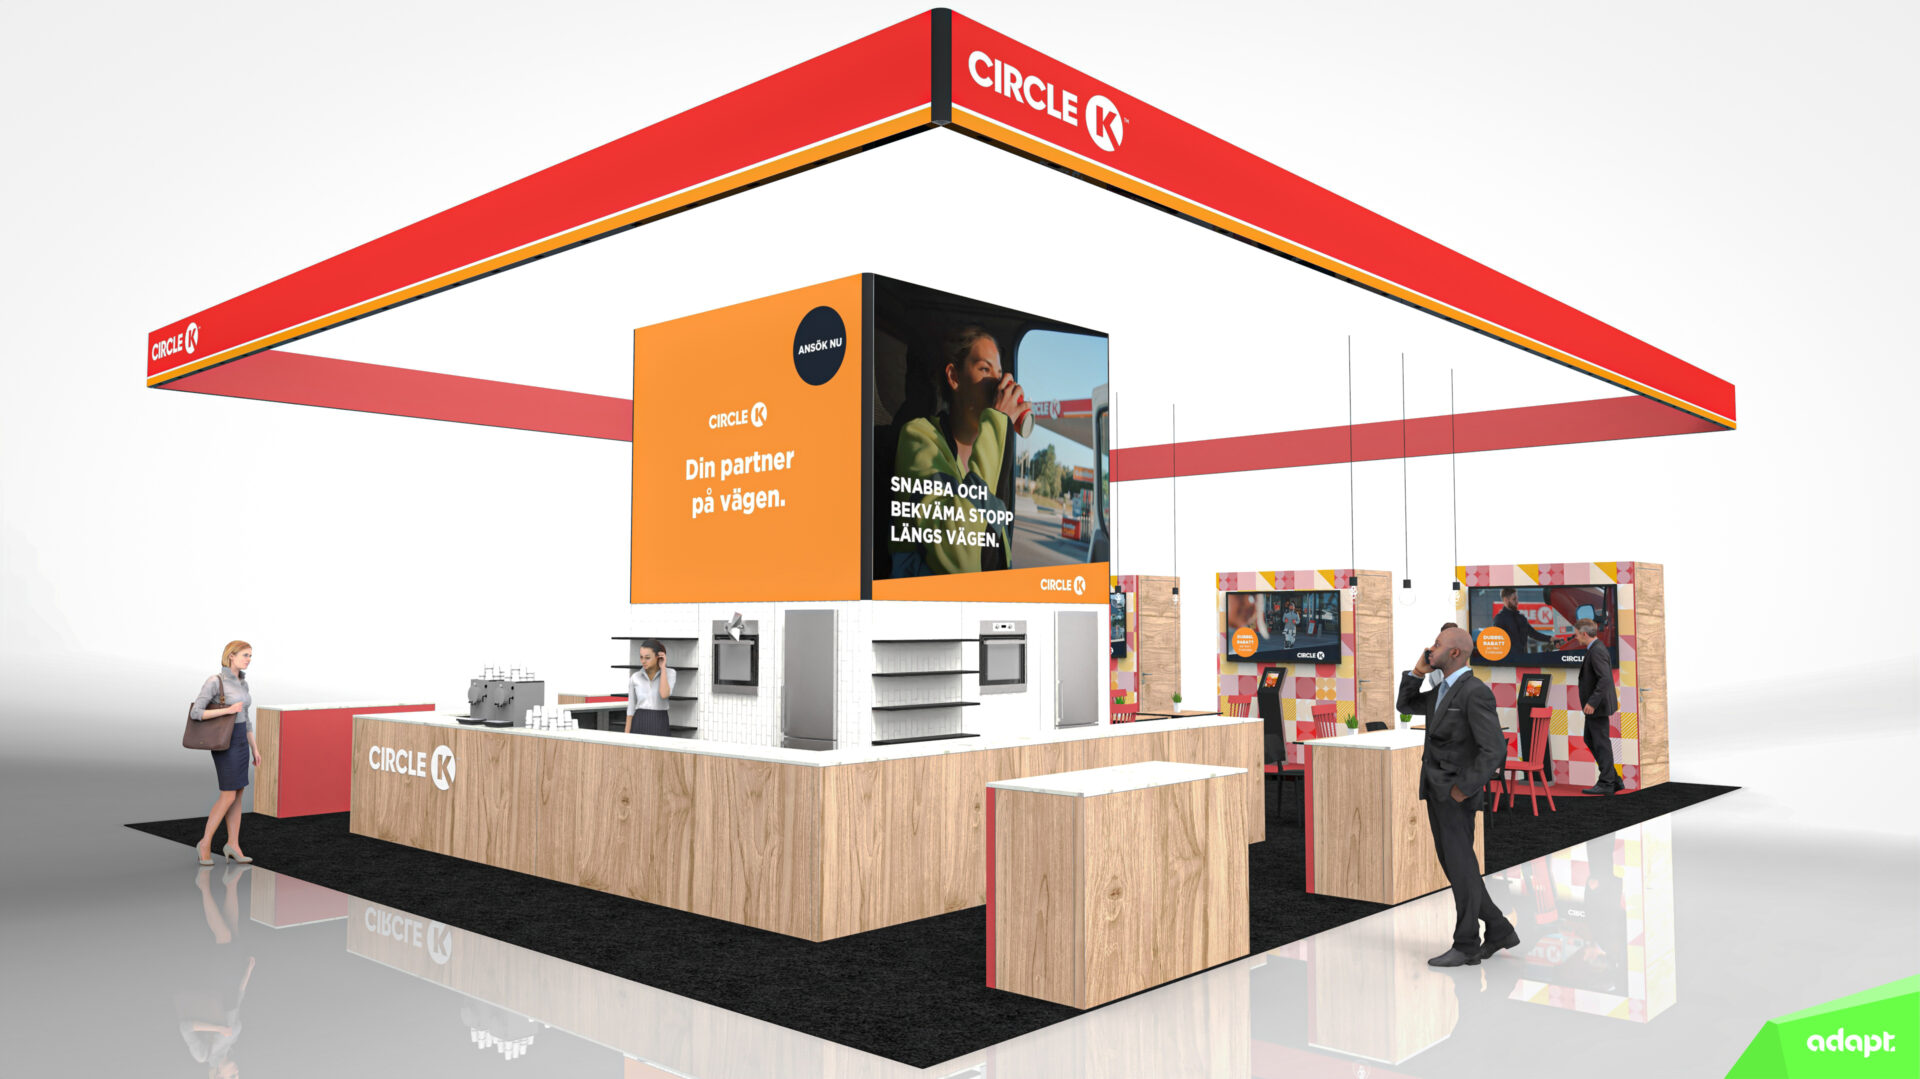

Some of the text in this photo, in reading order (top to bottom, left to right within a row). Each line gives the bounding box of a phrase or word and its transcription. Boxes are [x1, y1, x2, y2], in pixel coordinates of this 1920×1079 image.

[968, 50, 1078, 127] CIRCLE
[1085, 95, 1124, 152] K
[151, 322, 199, 361] CIRCLE K
[798, 337, 843, 355] ANSÖK NU
[708, 401, 768, 430] CIRCLE K
[685, 449, 795, 481] Din partner
[890, 475, 988, 500] SNABBA OCH
[692, 487, 786, 519] på vägen.
[890, 501, 1014, 526] BEKVÄMA STOPP
[890, 523, 1000, 548] LÄNGS VÄGEN.
[1040, 575, 1086, 596] CIRCLE K
[1316, 651, 1325, 660] K
[368, 744, 456, 790] CIRCLE K
